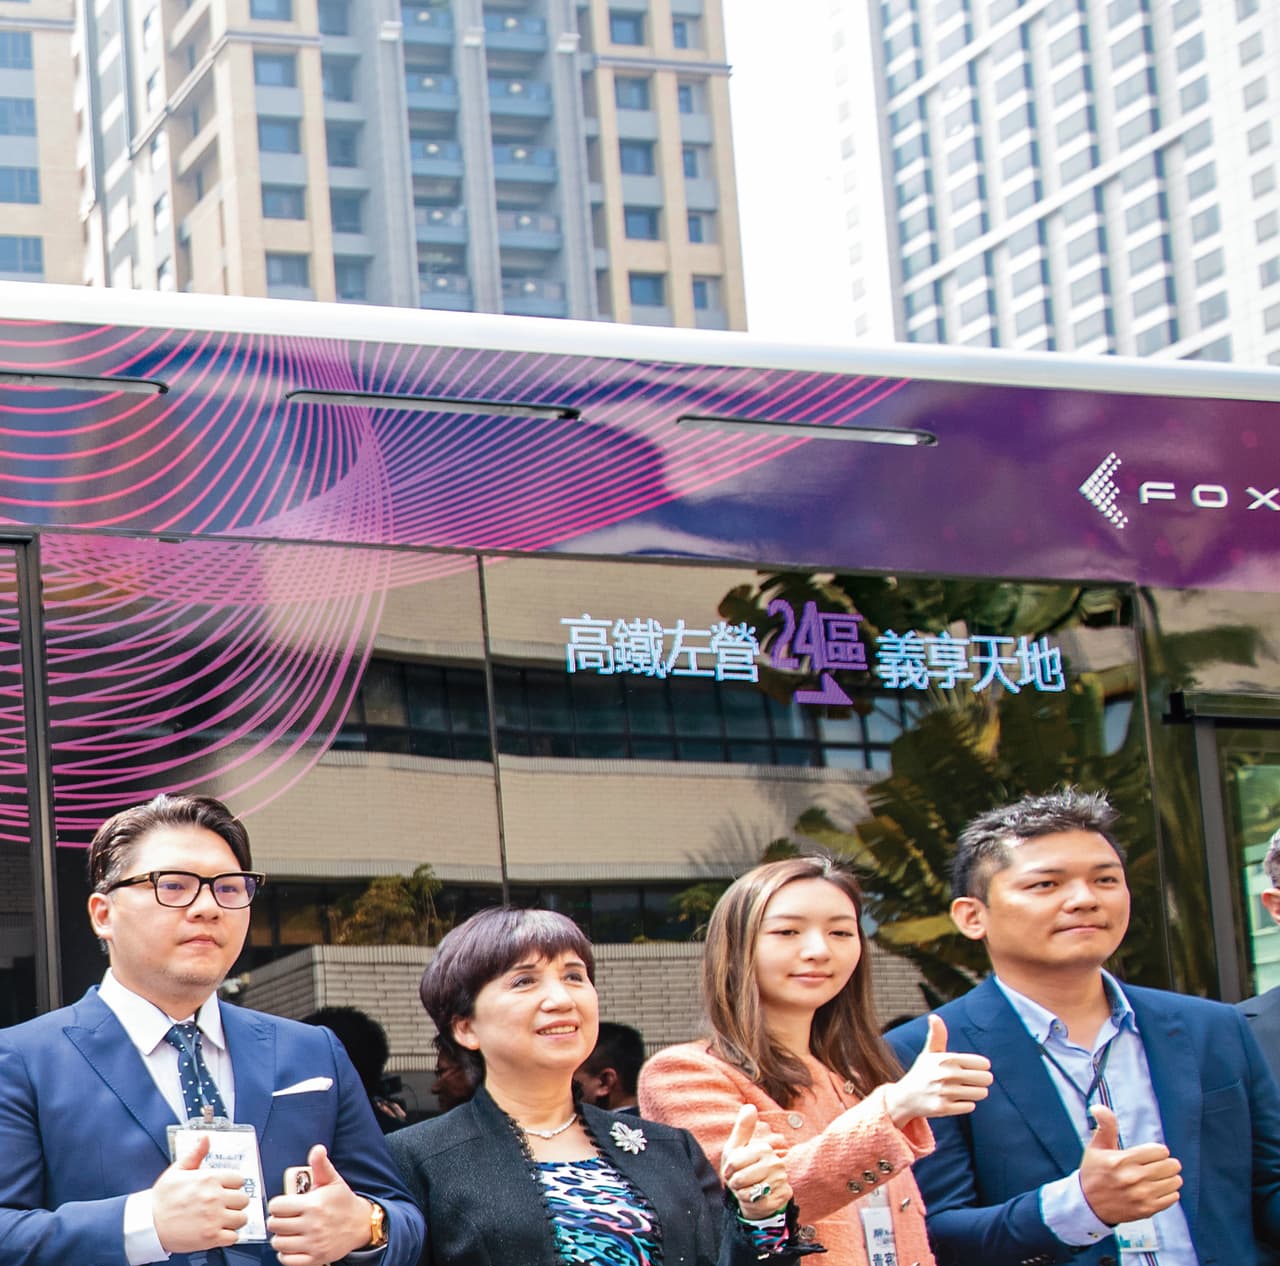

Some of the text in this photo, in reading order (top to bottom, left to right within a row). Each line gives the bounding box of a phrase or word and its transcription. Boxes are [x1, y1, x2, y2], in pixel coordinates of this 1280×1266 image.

[1139, 481, 1280, 511] FOX
[560, 599, 1066, 694] 高鐵左營 24區 義享天地
